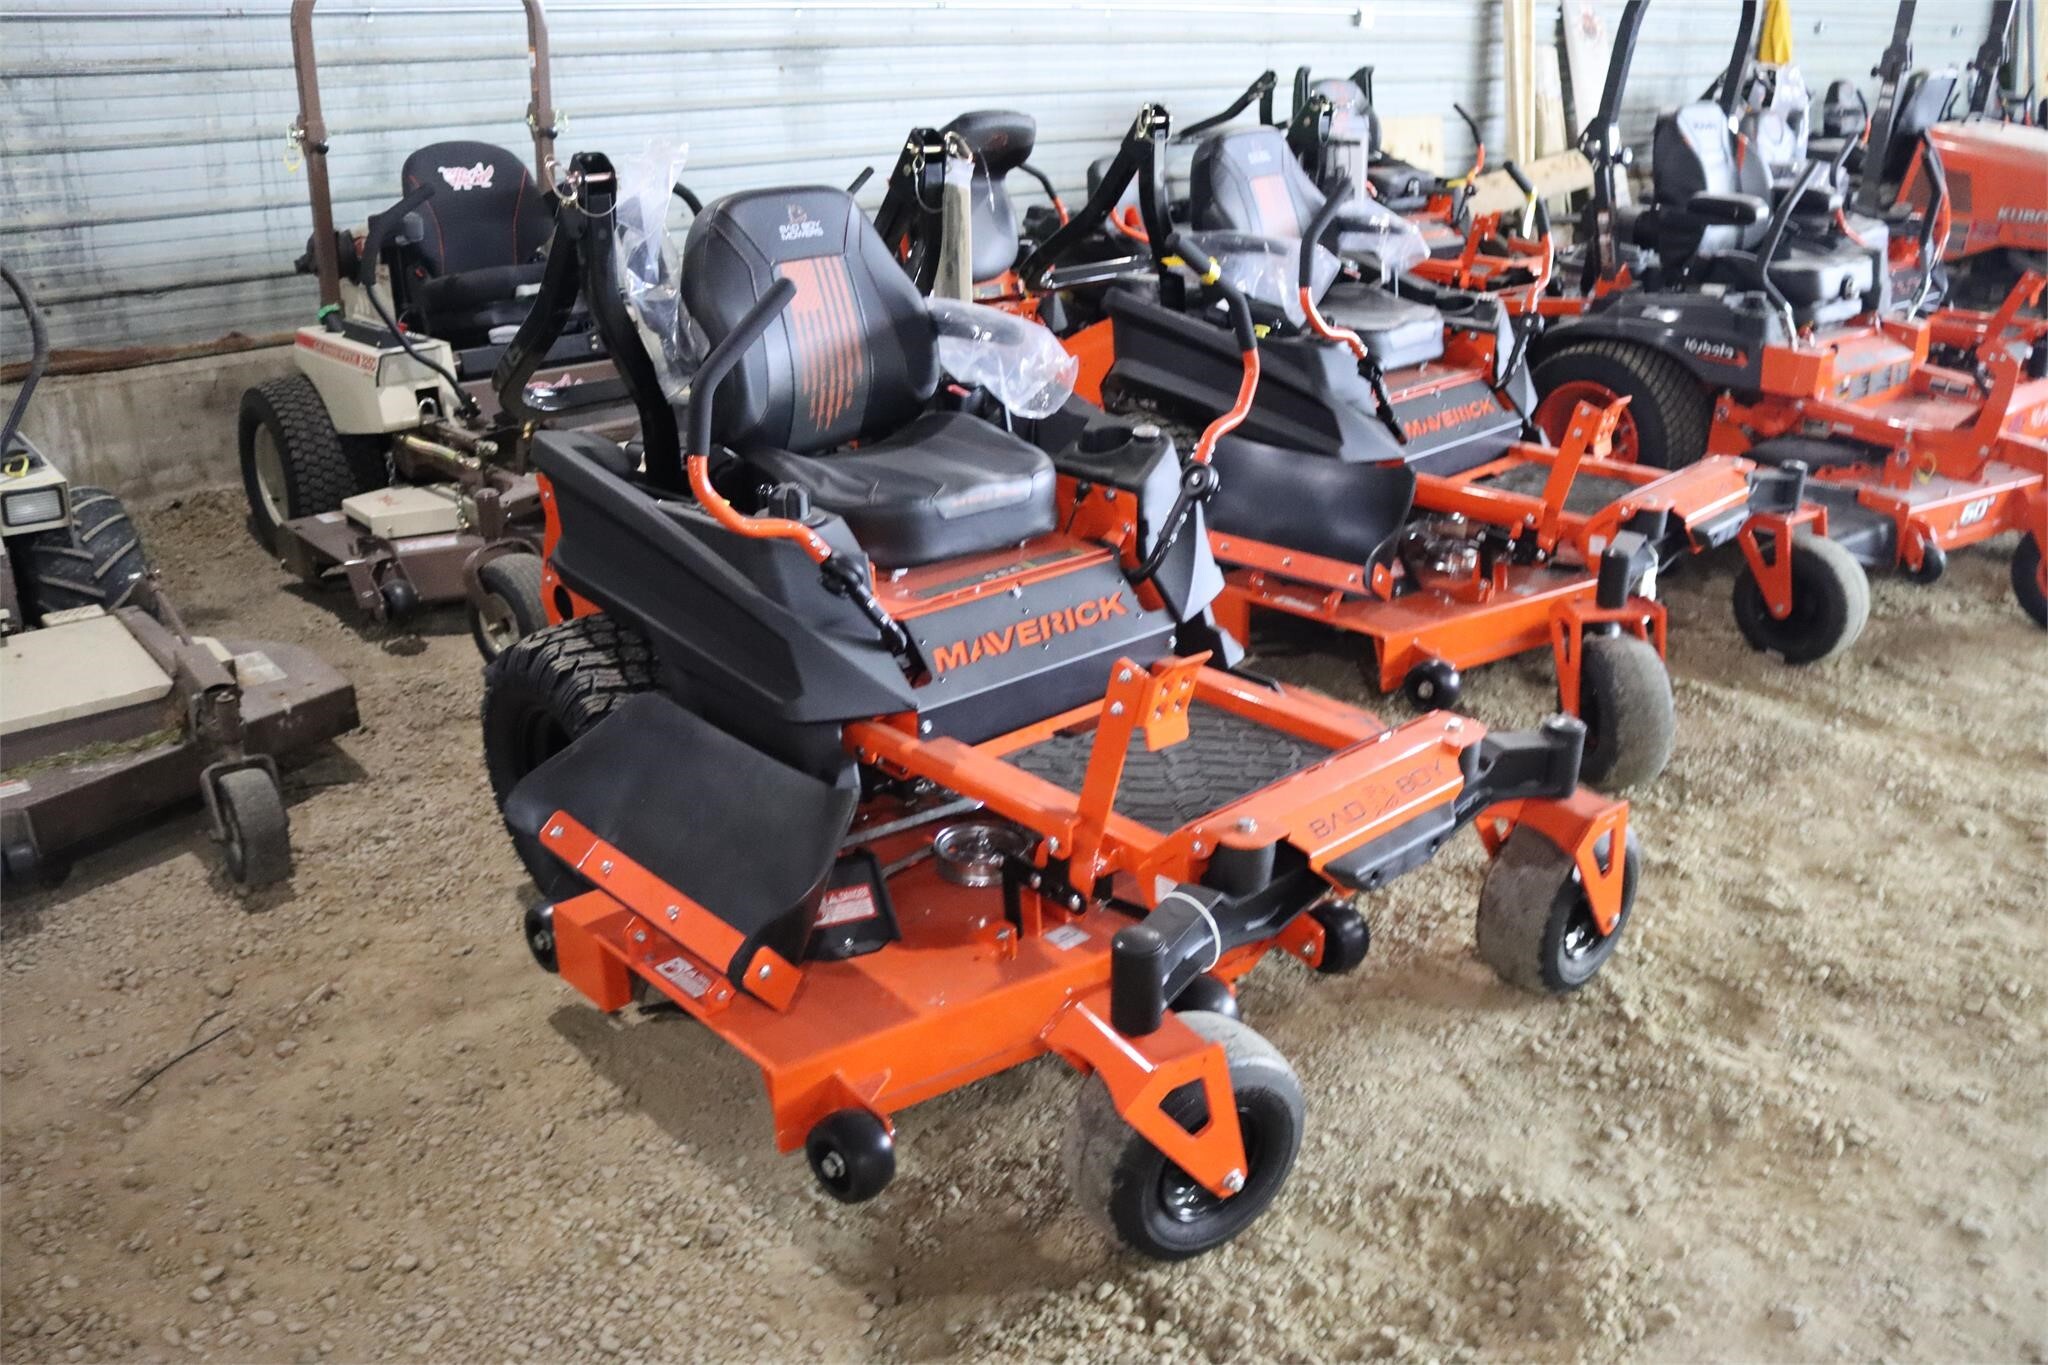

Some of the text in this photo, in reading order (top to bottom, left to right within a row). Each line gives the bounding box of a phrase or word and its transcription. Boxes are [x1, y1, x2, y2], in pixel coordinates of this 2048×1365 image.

[1404, 399, 1496, 440] MAVERICK
[932, 591, 1130, 674] MAVERICK
[1309, 801, 1367, 840] BAD
